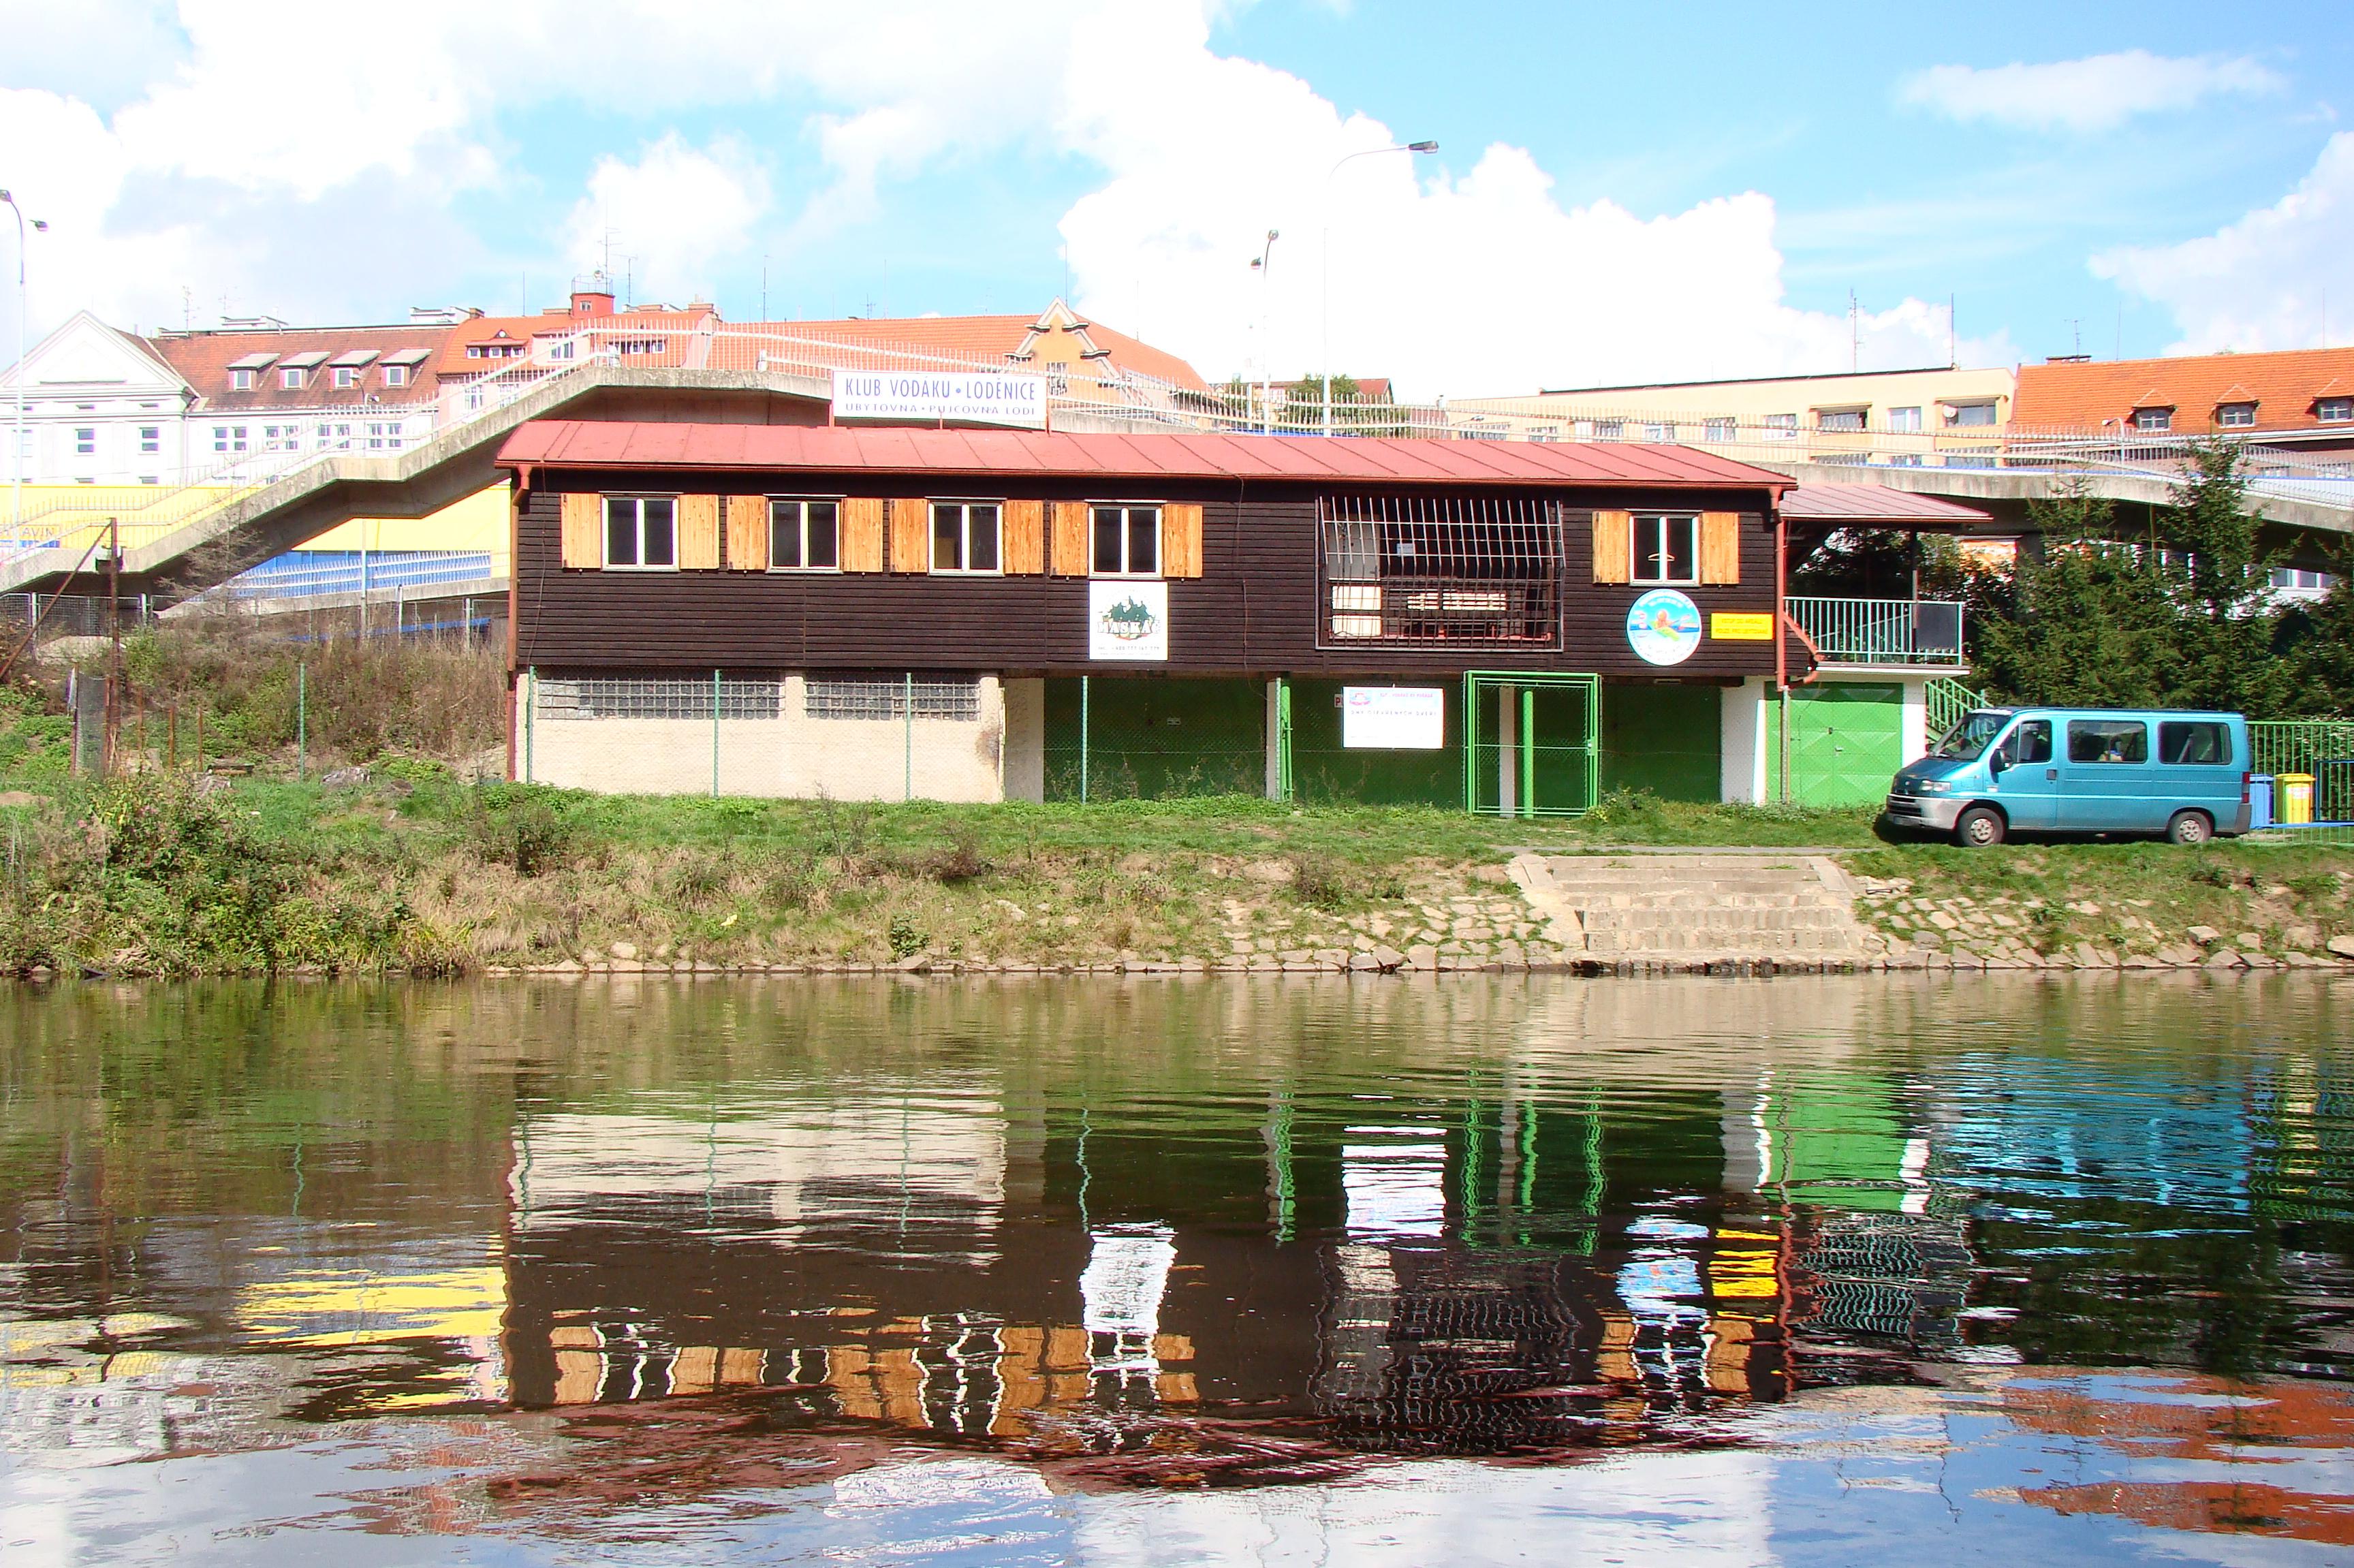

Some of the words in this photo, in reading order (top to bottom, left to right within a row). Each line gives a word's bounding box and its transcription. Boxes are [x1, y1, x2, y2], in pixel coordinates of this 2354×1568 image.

[845, 377, 881, 396] KLUB
[967, 377, 1035, 401] LODĚNICE
[845, 403, 917, 413] UBYTOVNA
